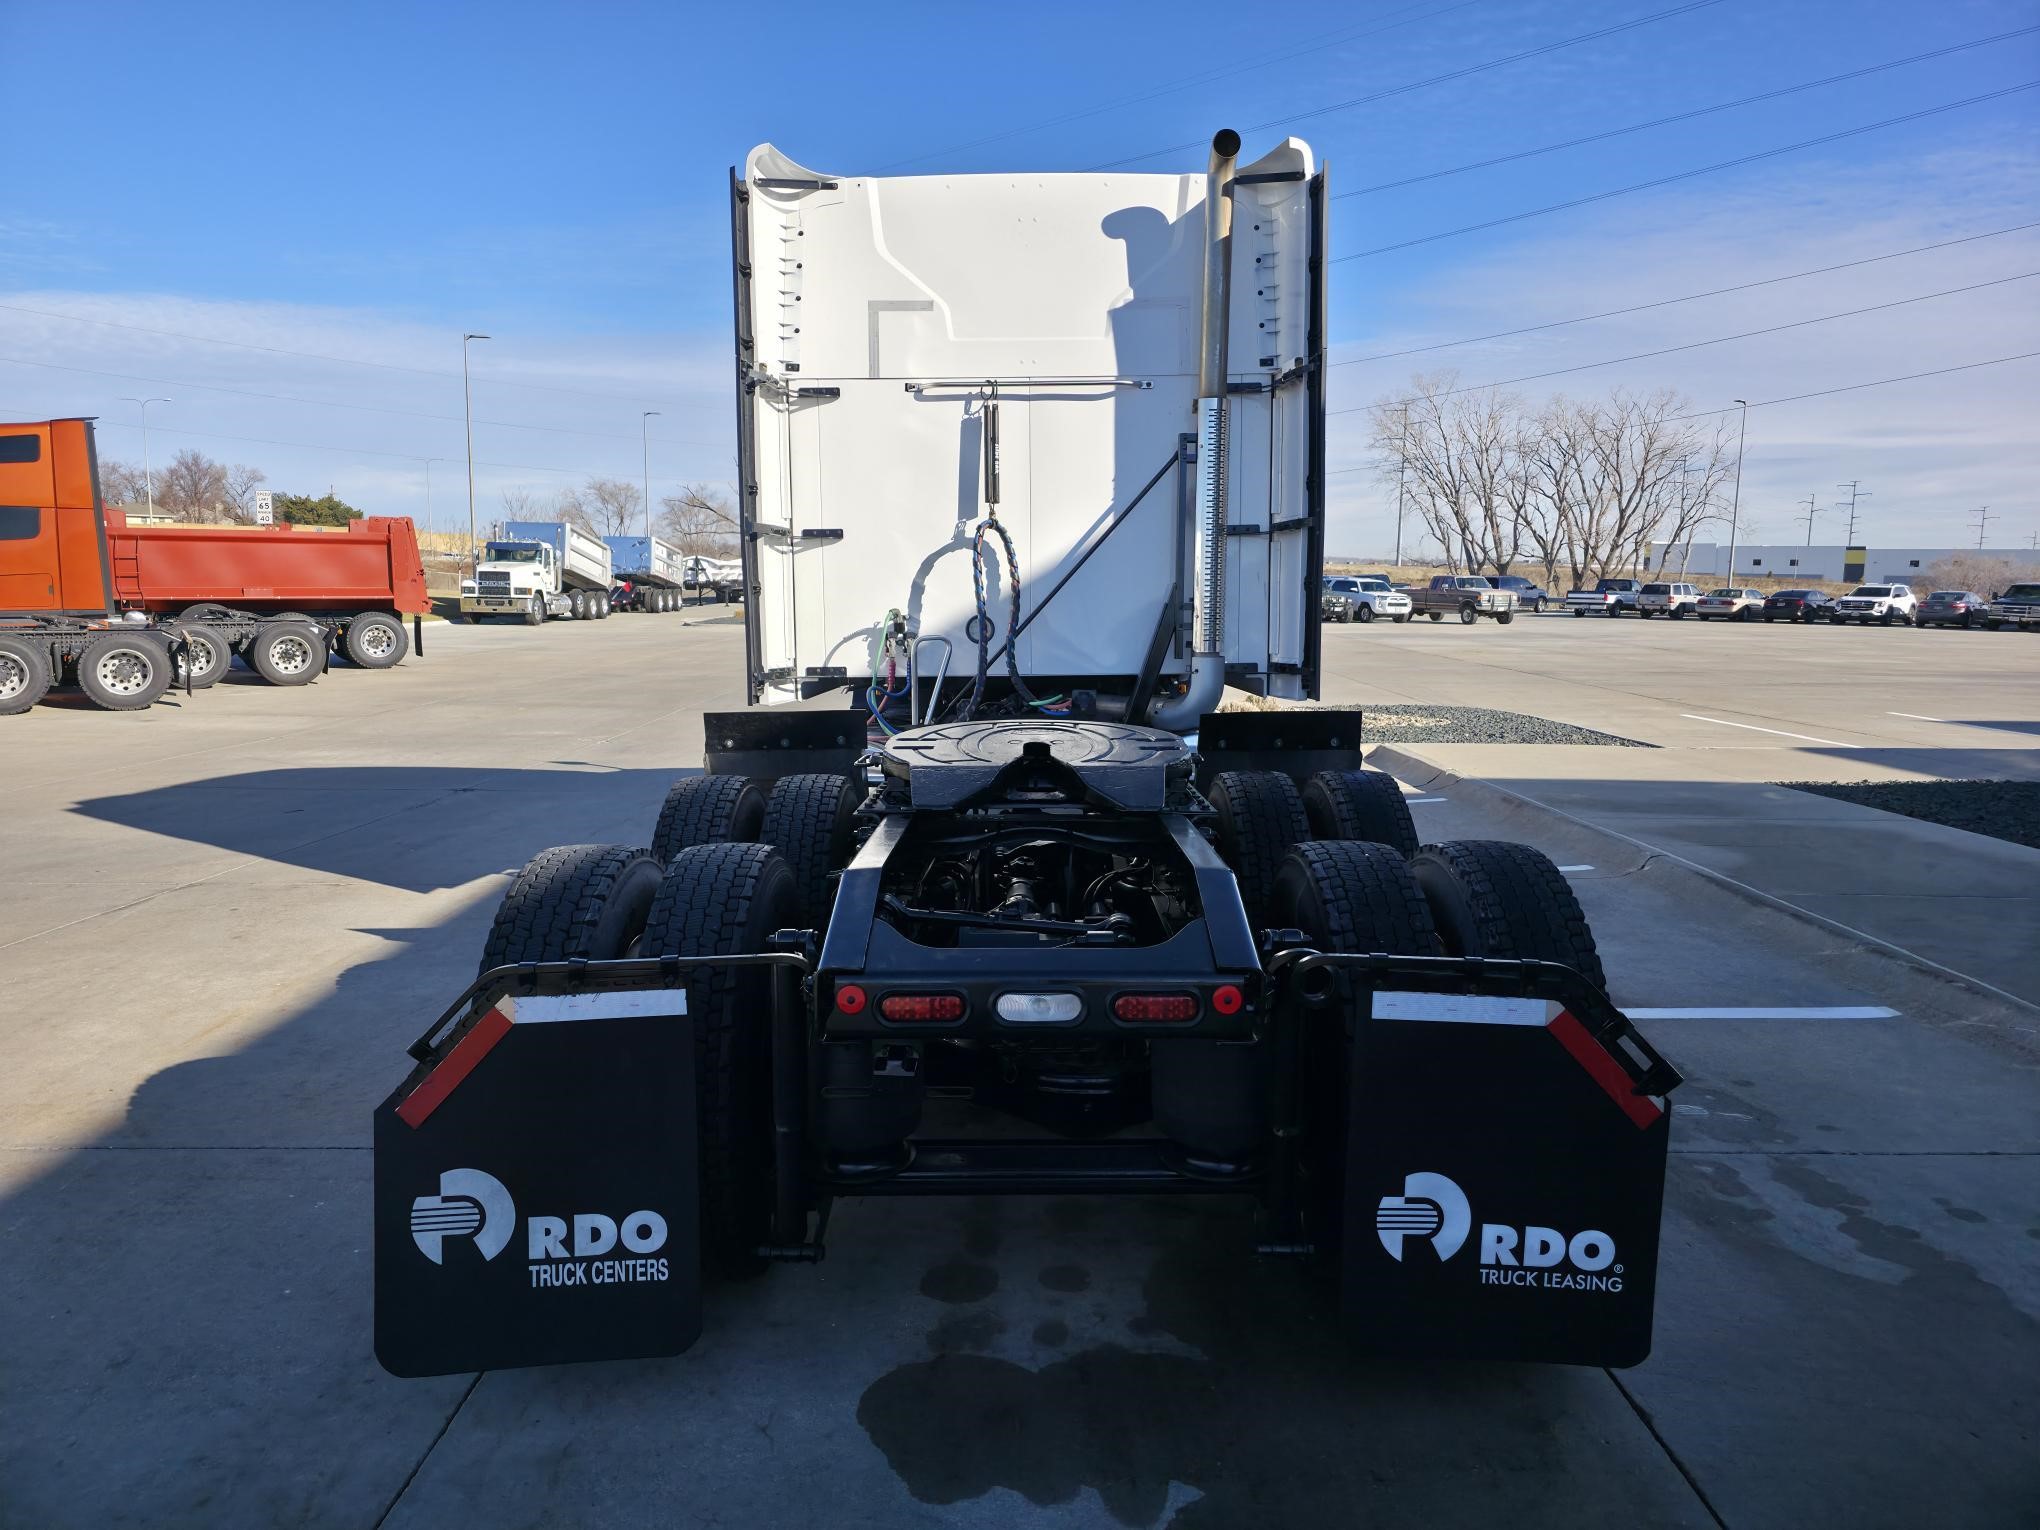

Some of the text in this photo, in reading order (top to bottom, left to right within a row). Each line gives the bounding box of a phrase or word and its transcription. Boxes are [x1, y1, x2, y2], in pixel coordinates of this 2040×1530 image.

[528, 1210, 668, 1259] RDO
[529, 1258, 669, 1287] TRUCK CENTERS
[1480, 1269, 1623, 1292] TRUCK LEASING
